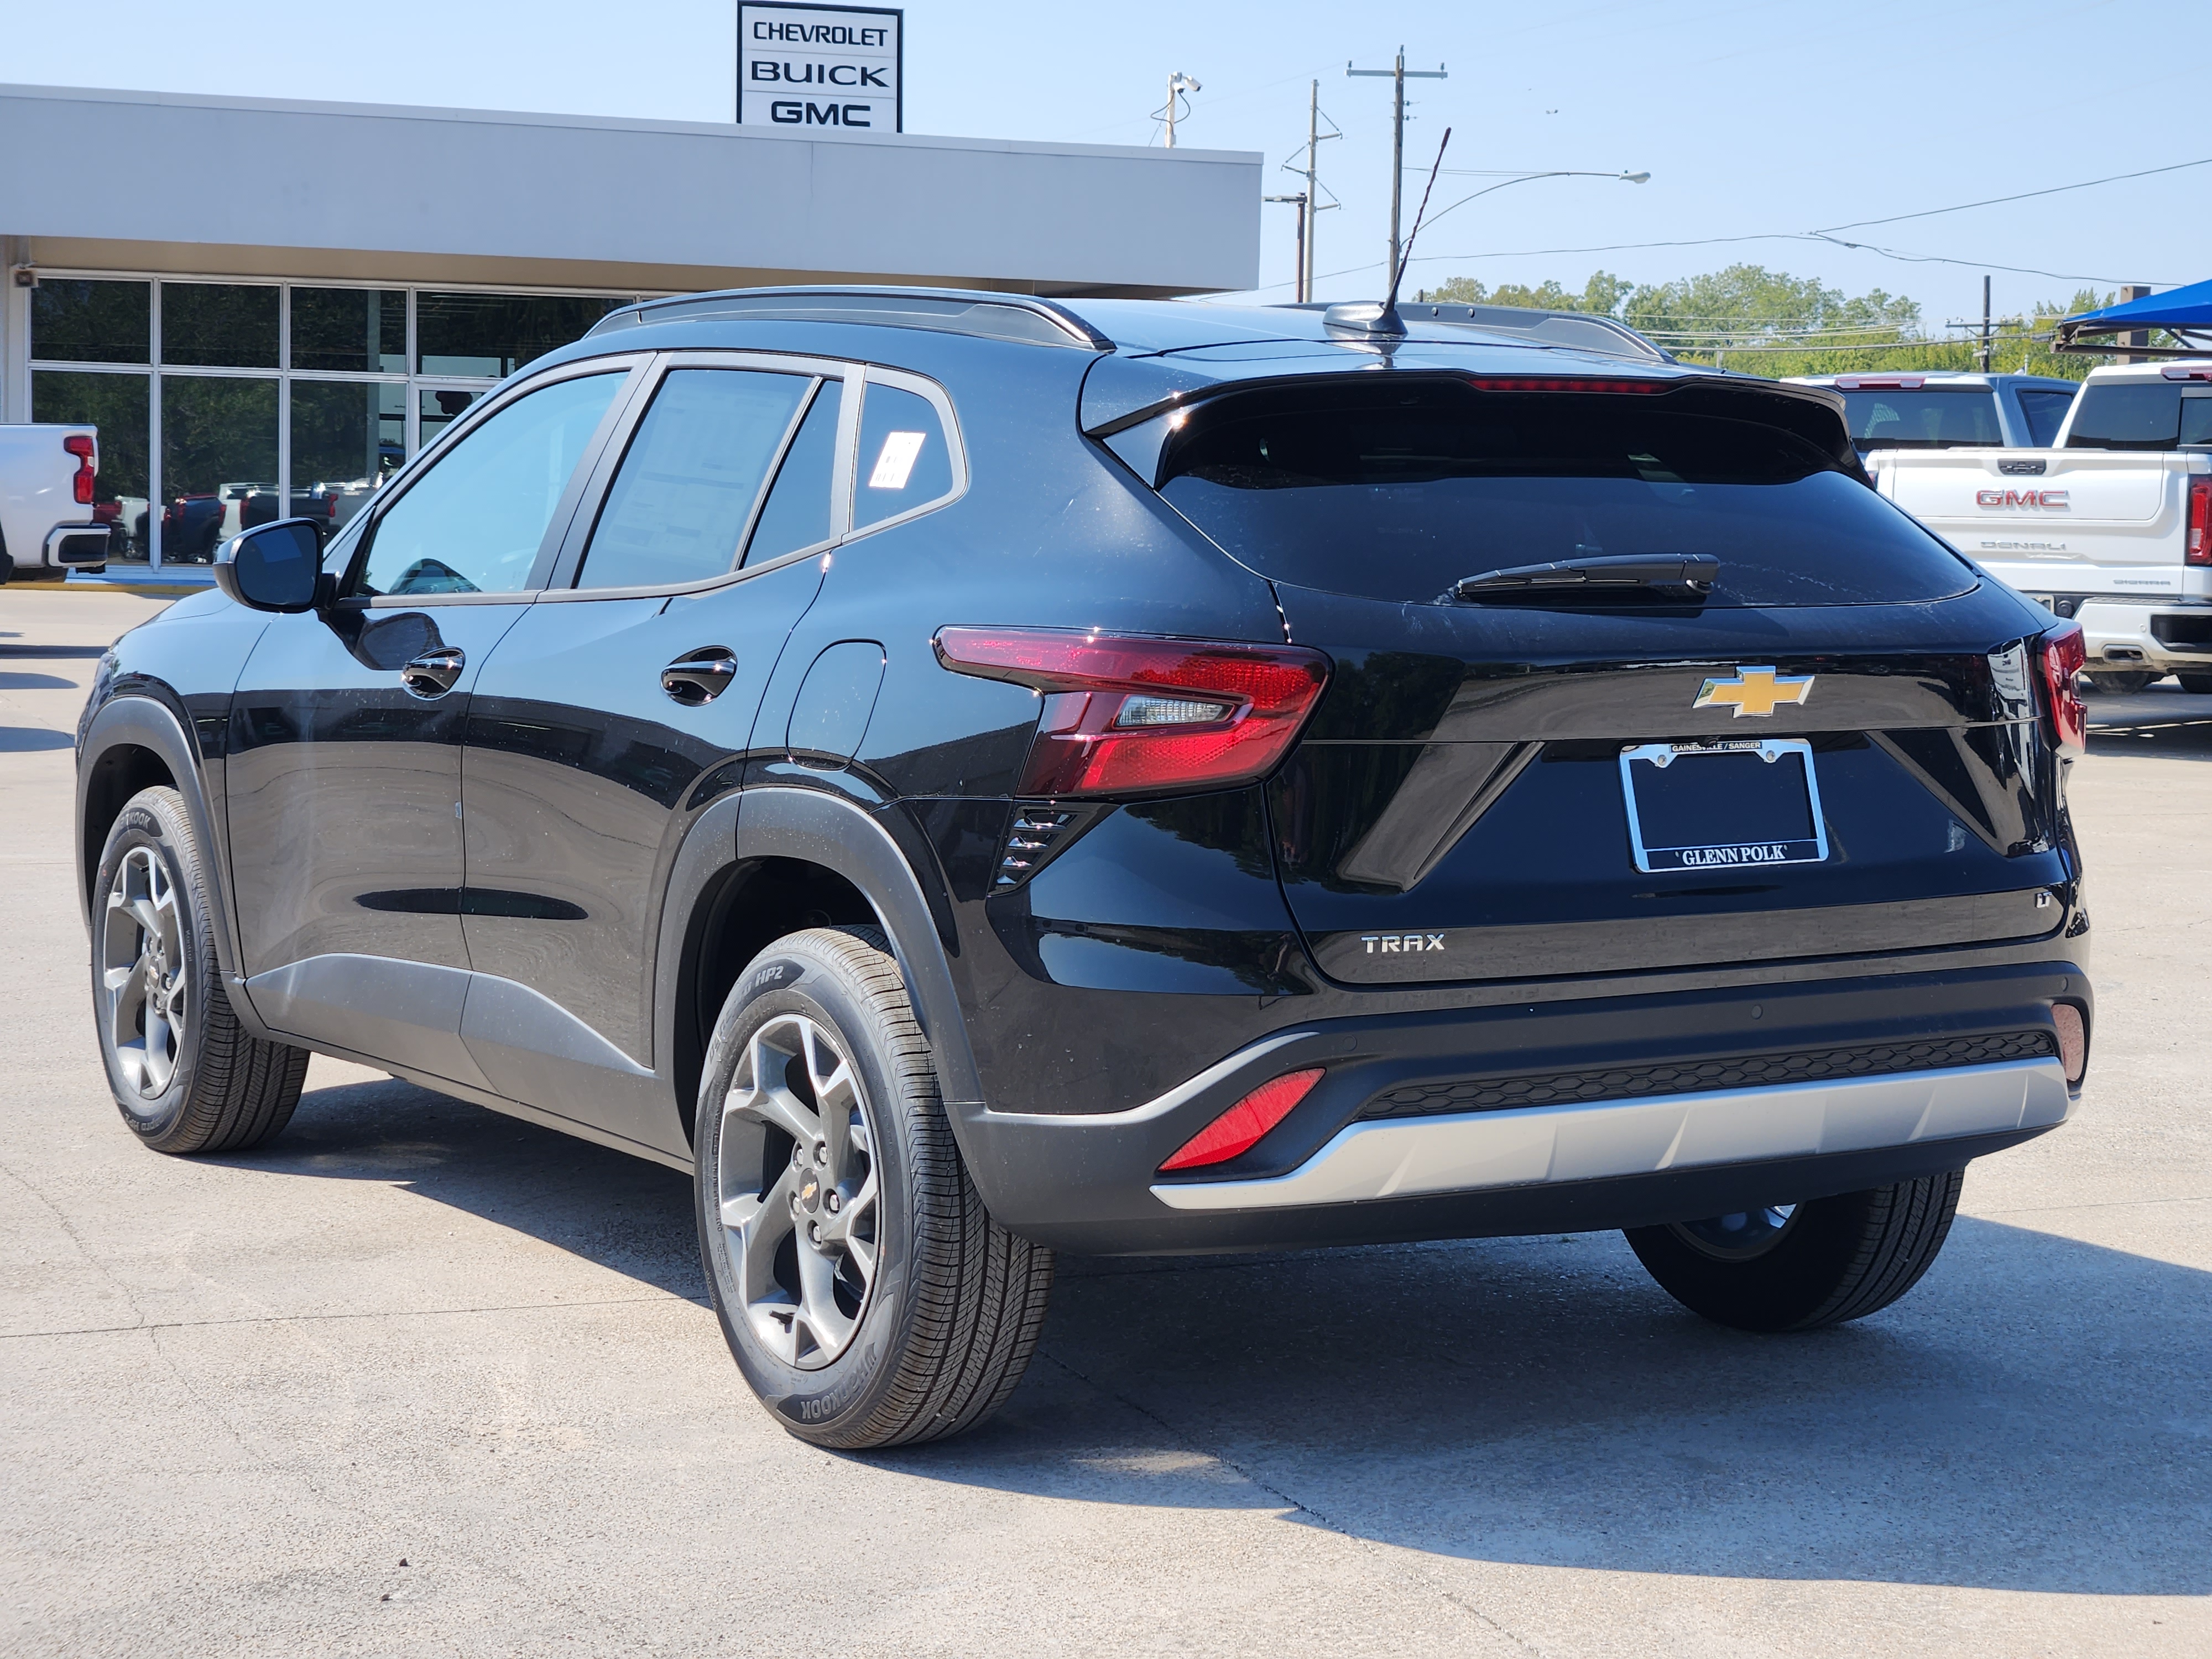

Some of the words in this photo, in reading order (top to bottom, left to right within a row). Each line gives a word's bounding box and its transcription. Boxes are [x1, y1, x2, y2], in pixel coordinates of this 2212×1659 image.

[754, 22, 888, 46] CHEVROLET
[752, 61, 890, 87] BUICK
[771, 101, 870, 127] GMC
[1976, 489, 2069, 508] GMC
[1981, 541, 2066, 551] DENALI
[1682, 848, 1739, 865] GLENN
[1740, 844, 1786, 862] POLK
[1360, 933, 1445, 953] TRAX
[755, 965, 784, 988] HP2
